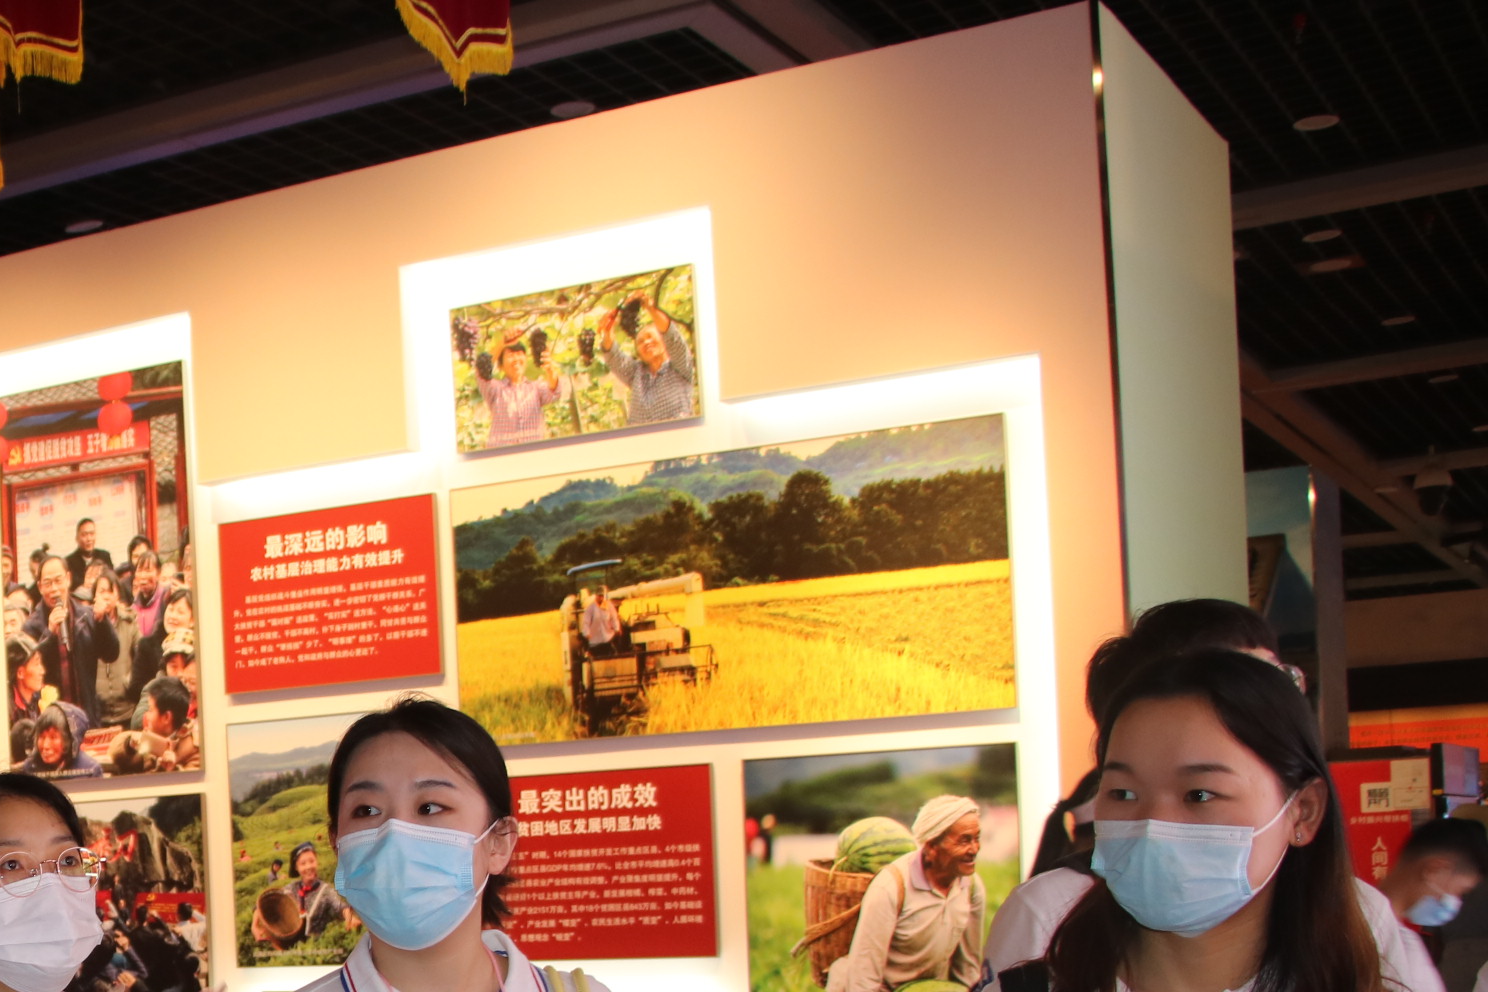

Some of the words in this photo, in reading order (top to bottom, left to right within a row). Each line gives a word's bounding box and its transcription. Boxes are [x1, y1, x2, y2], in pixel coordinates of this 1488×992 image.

[264, 521, 388, 559] 最深远的影响
[250, 548, 404, 582] 农村基层治理能力有效提升
[517, 782, 657, 815] 最突出的成效
[518, 814, 661, 838] 贫困地区发展明显加快
